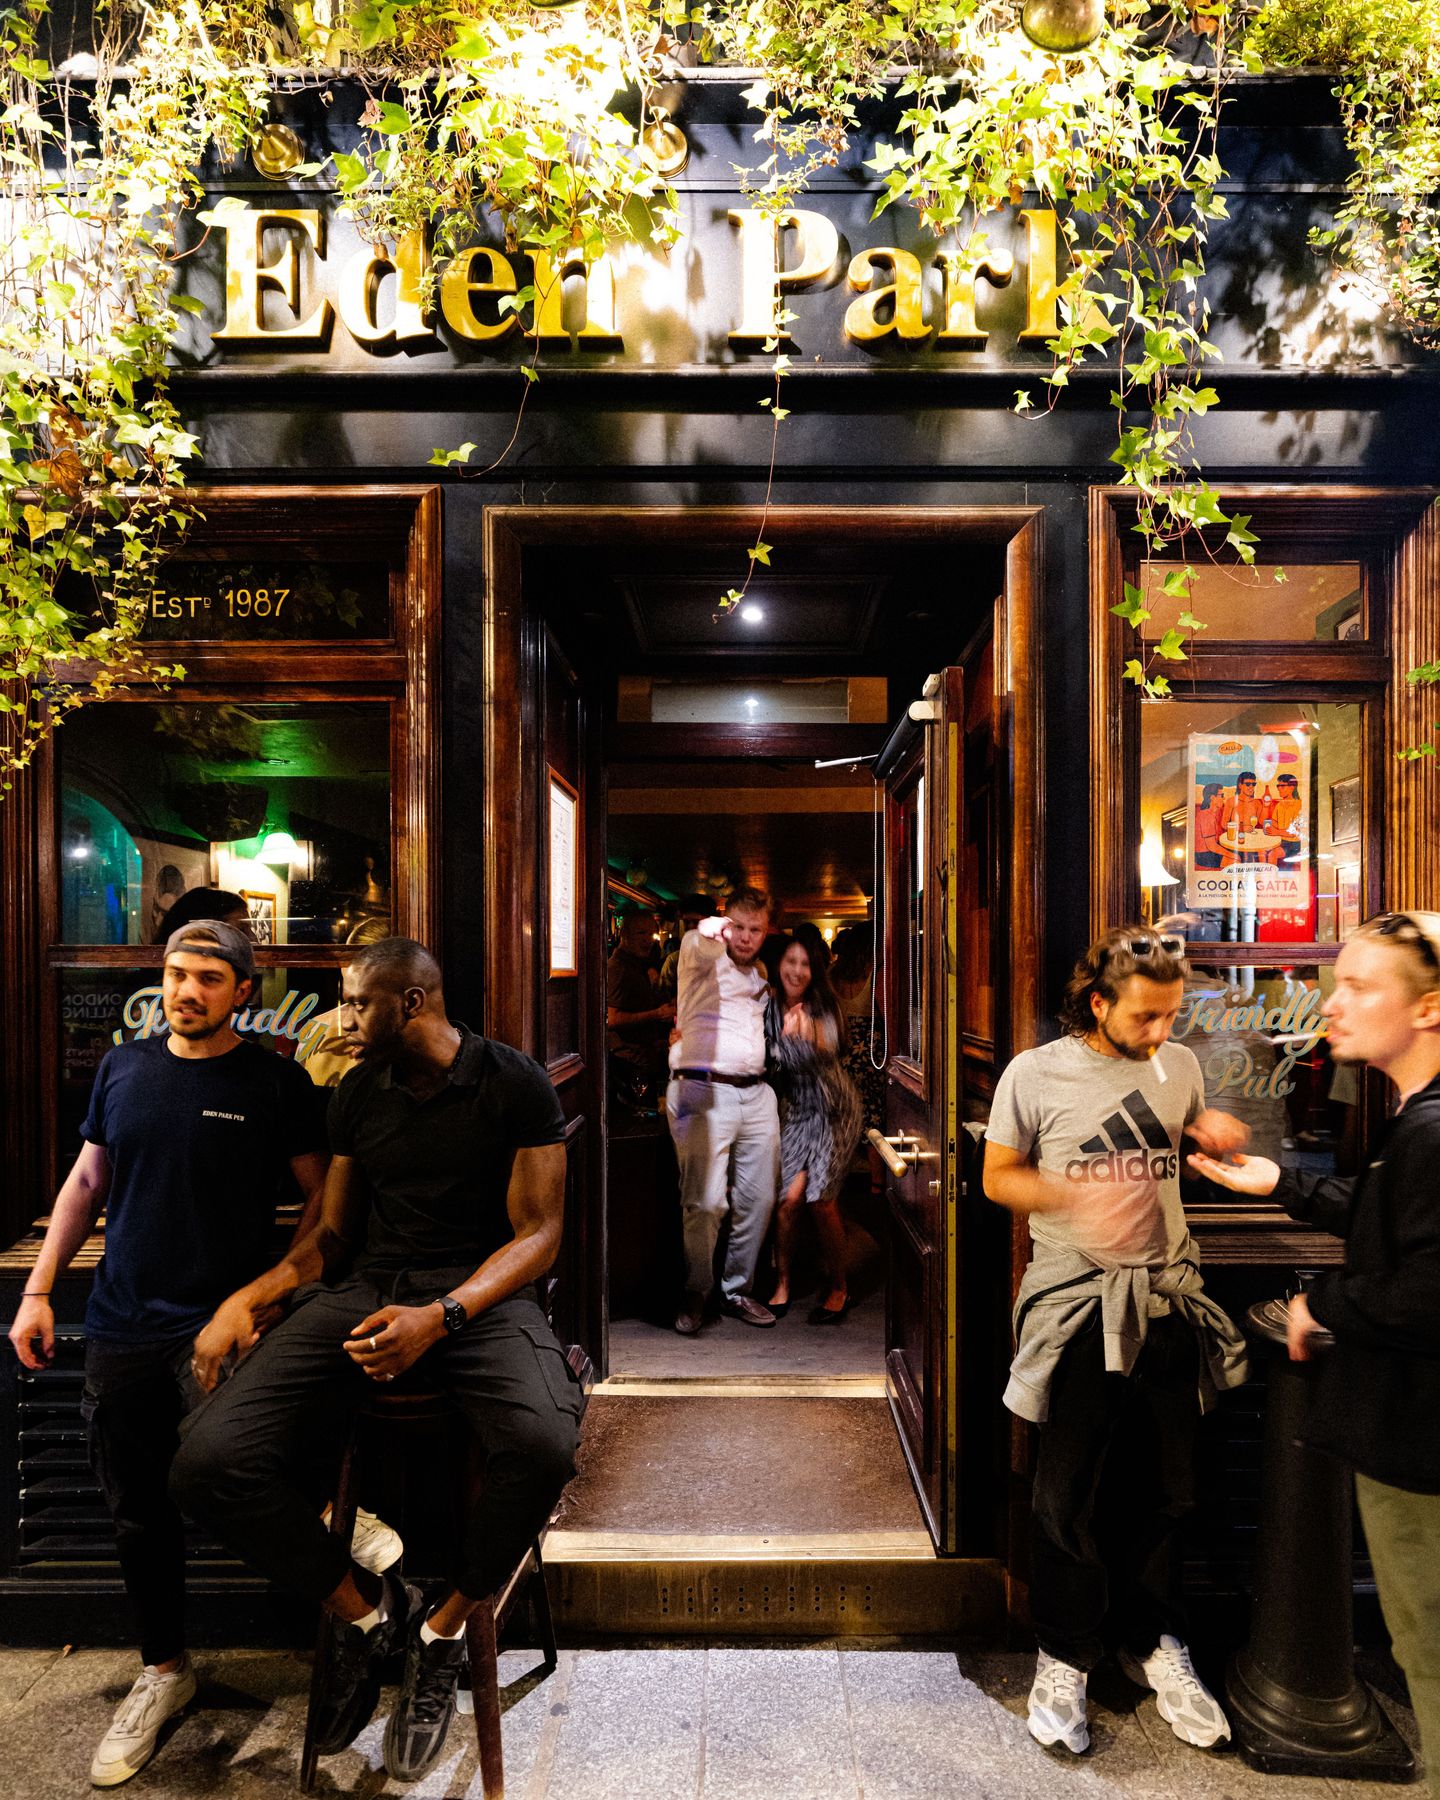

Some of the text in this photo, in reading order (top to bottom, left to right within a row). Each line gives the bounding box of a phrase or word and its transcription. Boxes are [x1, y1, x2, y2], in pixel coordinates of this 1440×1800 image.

[211, 207, 1120, 345] Eden Park
[225, 588, 290, 617] 1987
[1197, 880, 1298, 891] COOLAGATTA
[1168, 987, 1329, 1057] Friendly
[1203, 1046, 1297, 1099] Pub
[1065, 1148, 1178, 1184] adidas
